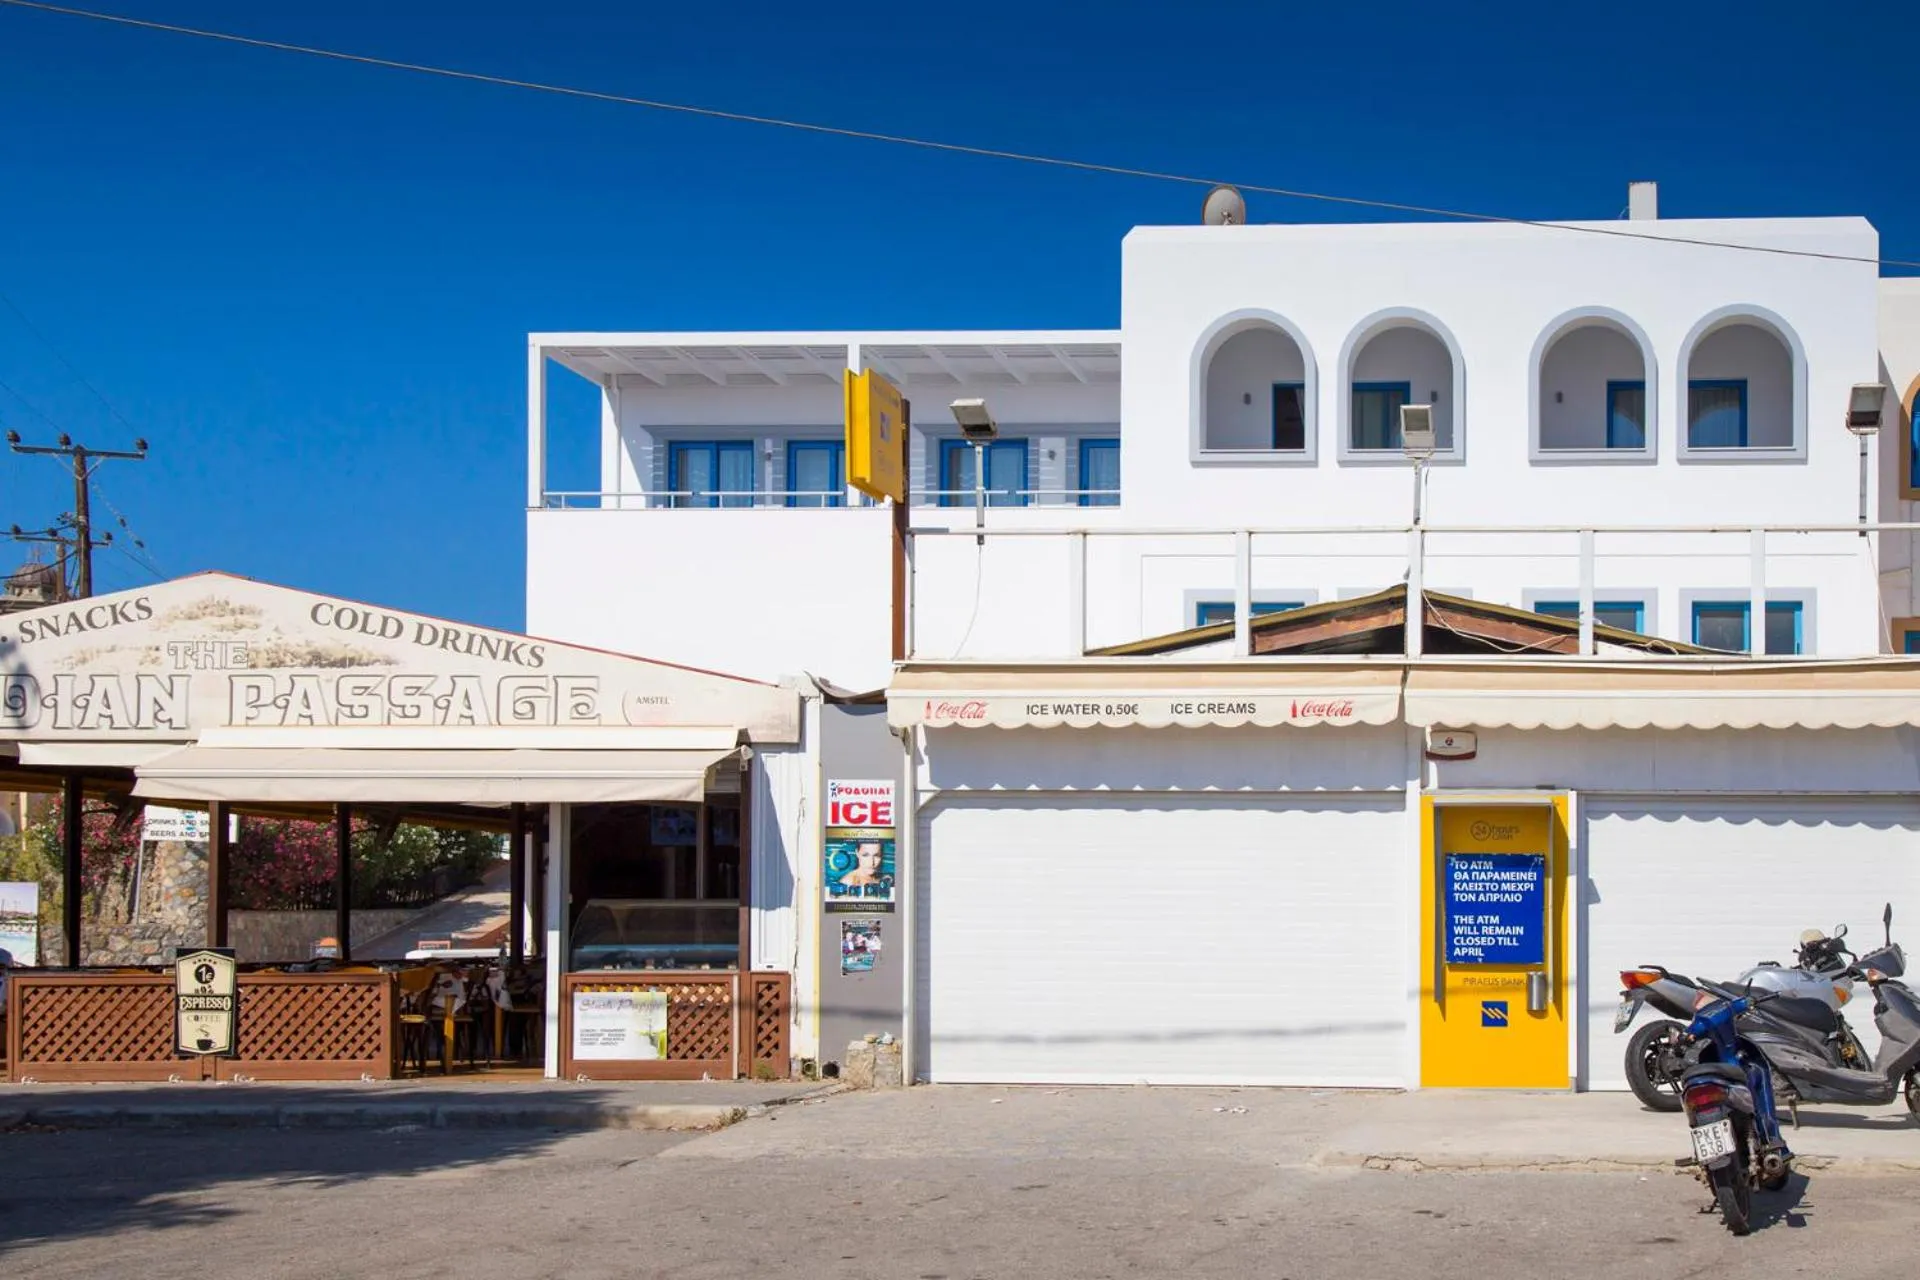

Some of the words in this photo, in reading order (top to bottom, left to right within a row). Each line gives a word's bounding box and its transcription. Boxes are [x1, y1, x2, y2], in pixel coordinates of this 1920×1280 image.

[18, 597, 153, 643] SNACKS
[311, 602, 404, 640] COLD
[415, 621, 545, 668] DRINKS
[167, 640, 249, 671] THE
[228, 674, 602, 726] PASSAGE
[636, 695, 671, 705] AMSTEL
[1026, 704, 1048, 716] ICE
[1052, 704, 1101, 716] WATER
[1170, 703, 1193, 715] ICE
[1197, 702, 1257, 715] CREAMS
[831, 801, 892, 825] ICE
[1453, 871, 1469, 881] ΘΑ
[1471, 871, 1537, 881] ΠΑΡΑΜΕΙΝΕΙ
[1453, 882, 1499, 891] ΚΛΕΙΣΤΟ
[1500, 882, 1534, 891] ΜΕΧΡΙ
[1453, 893, 1476, 902] ΤΟΝ
[1478, 893, 1523, 902] ΑΠΡΙΛΙΟ
[1454, 915, 1474, 924] THE
[1476, 915, 1500, 924] ATM
[1453, 925, 1480, 935] WILL
[1481, 925, 1524, 935] REMAIN
[1453, 936, 1496, 946] CLOSED
[1497, 936, 1519, 946] TILL
[1453, 947, 1485, 956] APRIL
[1463, 978, 1501, 987] PIRAEUS
[179, 996, 232, 1011] ESPRESSO
[1699, 1140, 1724, 1158] 638
